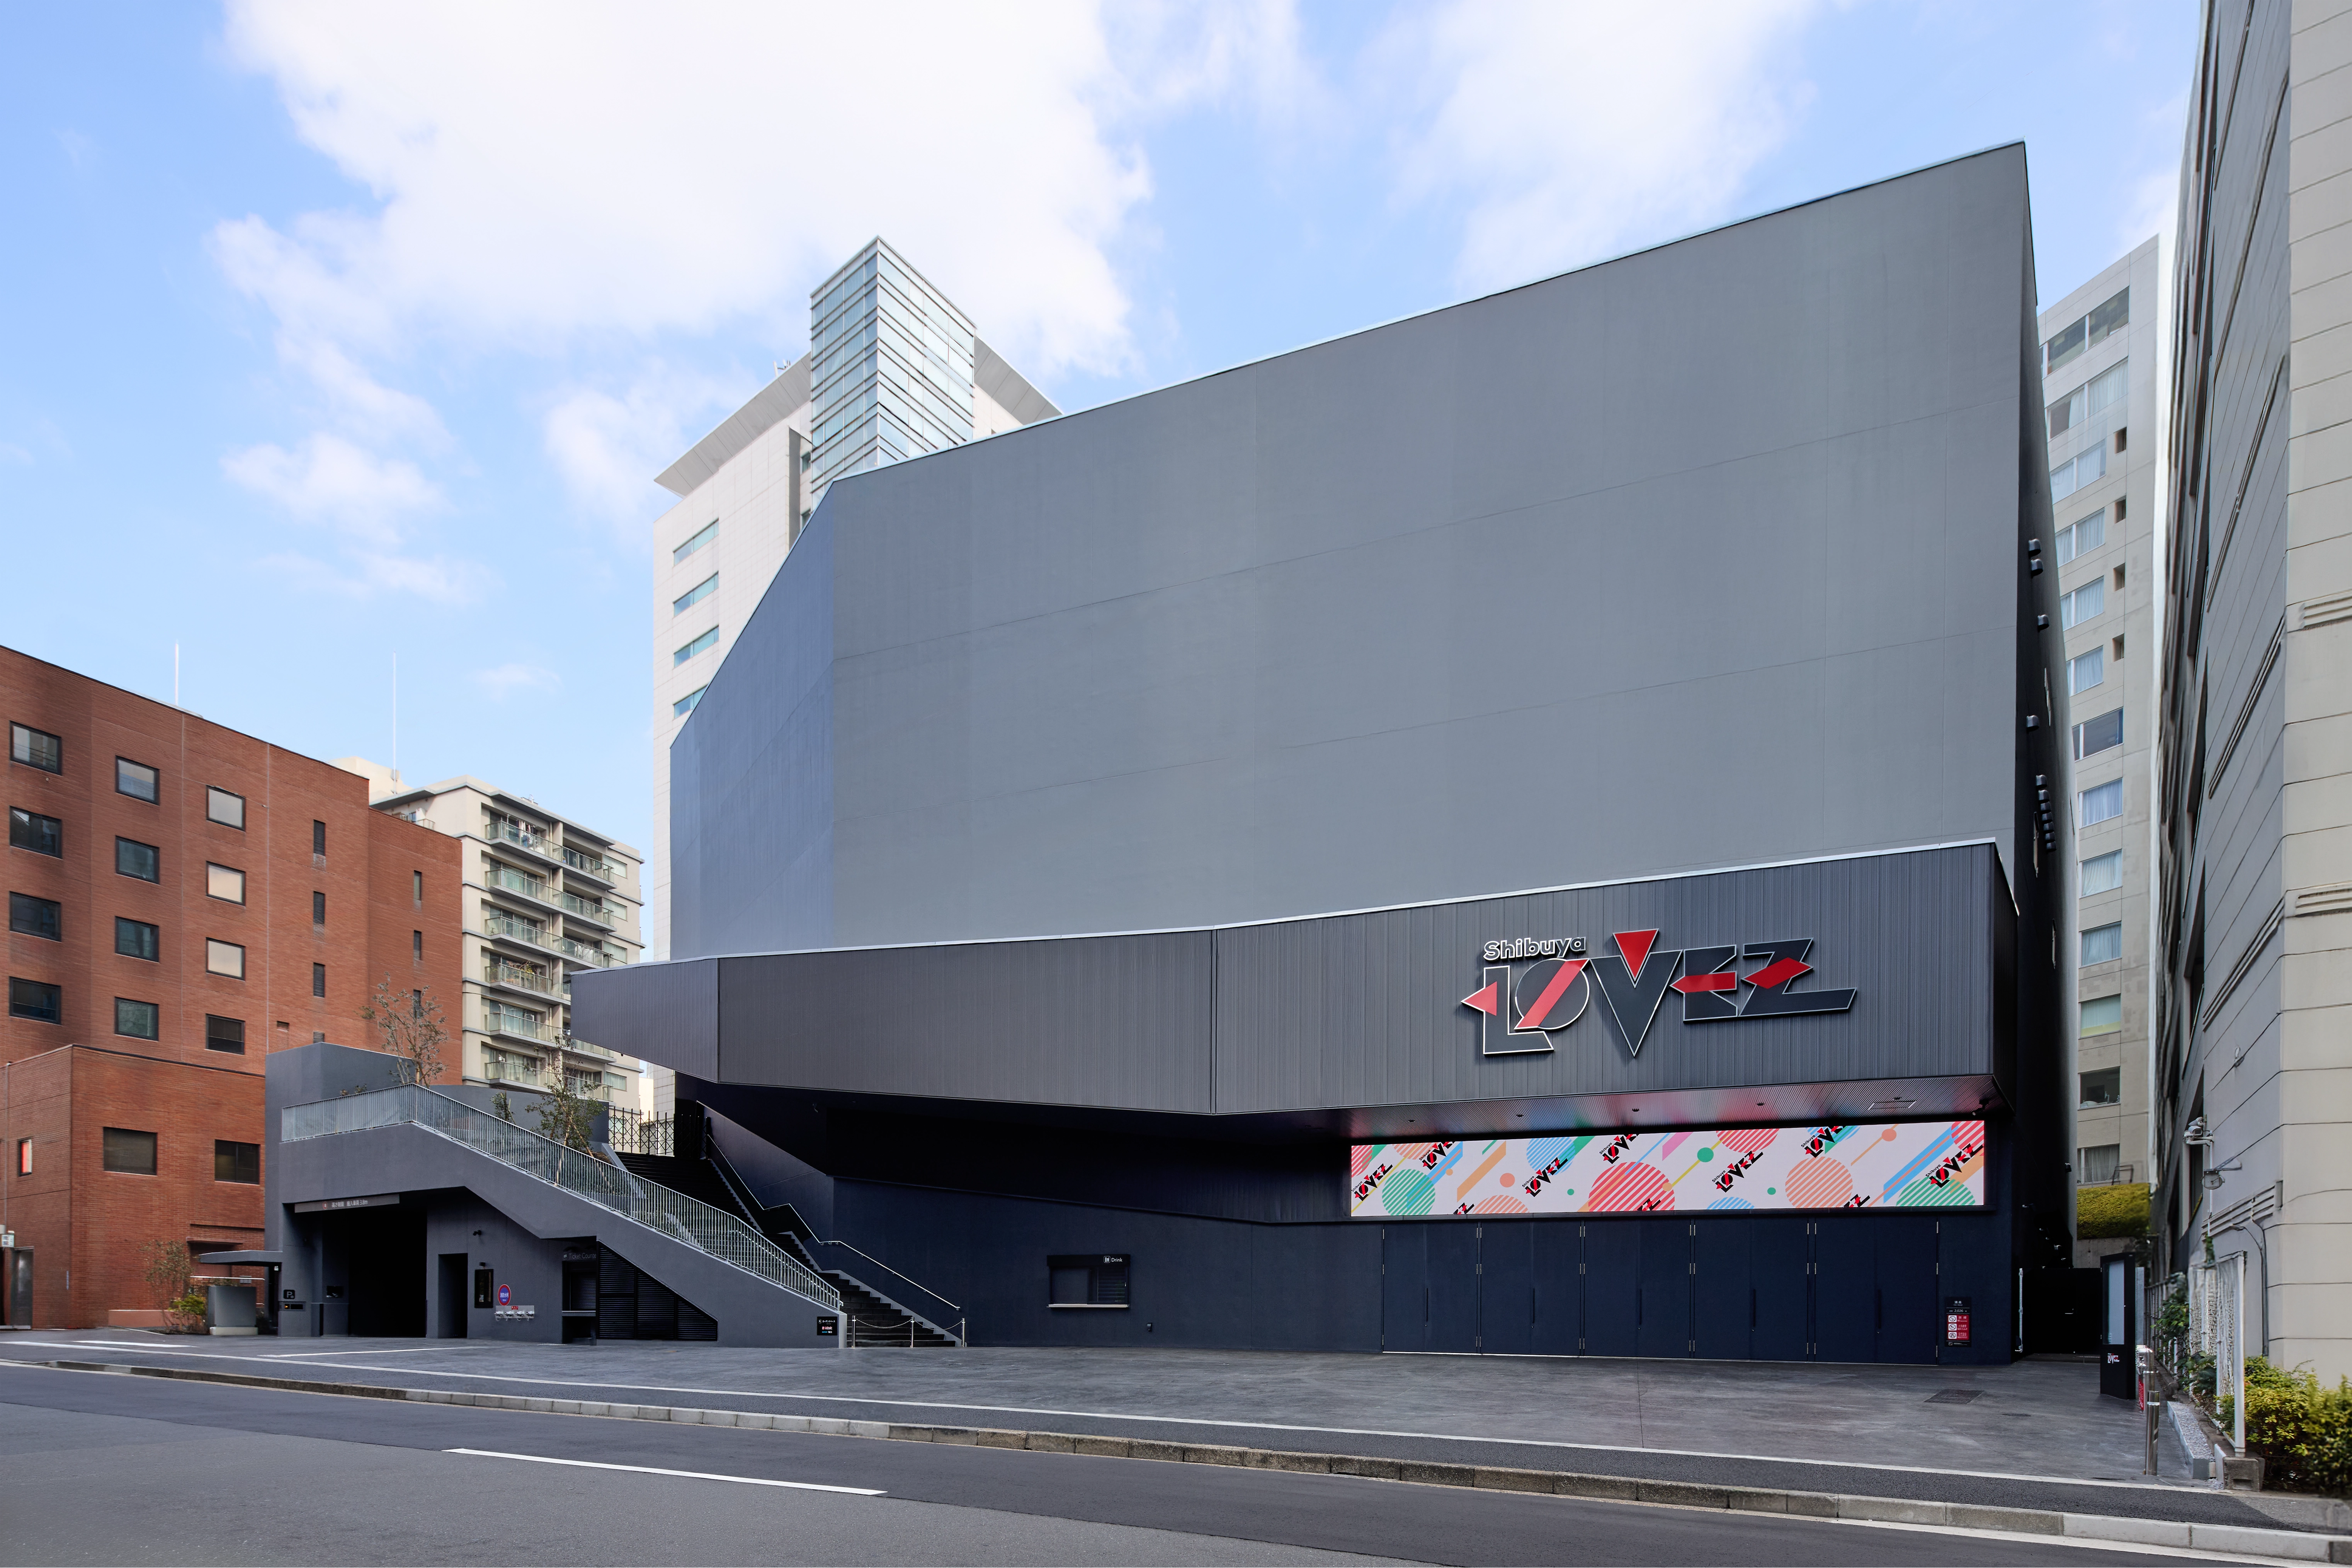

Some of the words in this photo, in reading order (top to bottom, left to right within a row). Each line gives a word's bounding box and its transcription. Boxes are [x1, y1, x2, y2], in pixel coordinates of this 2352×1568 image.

[1483, 937, 1586, 961] Shibuya
[1801, 1135, 1815, 1148] Shibuya
[1599, 1143, 1612, 1154] Shibuya
[1419, 1150, 1431, 1161] Shibuya
[1712, 1170, 1726, 1182] Shibuya
[1925, 1164, 1941, 1177] Shibuya
[1351, 1181, 1362, 1192] Shibuya
[1522, 1176, 1534, 1187] Shibuya
